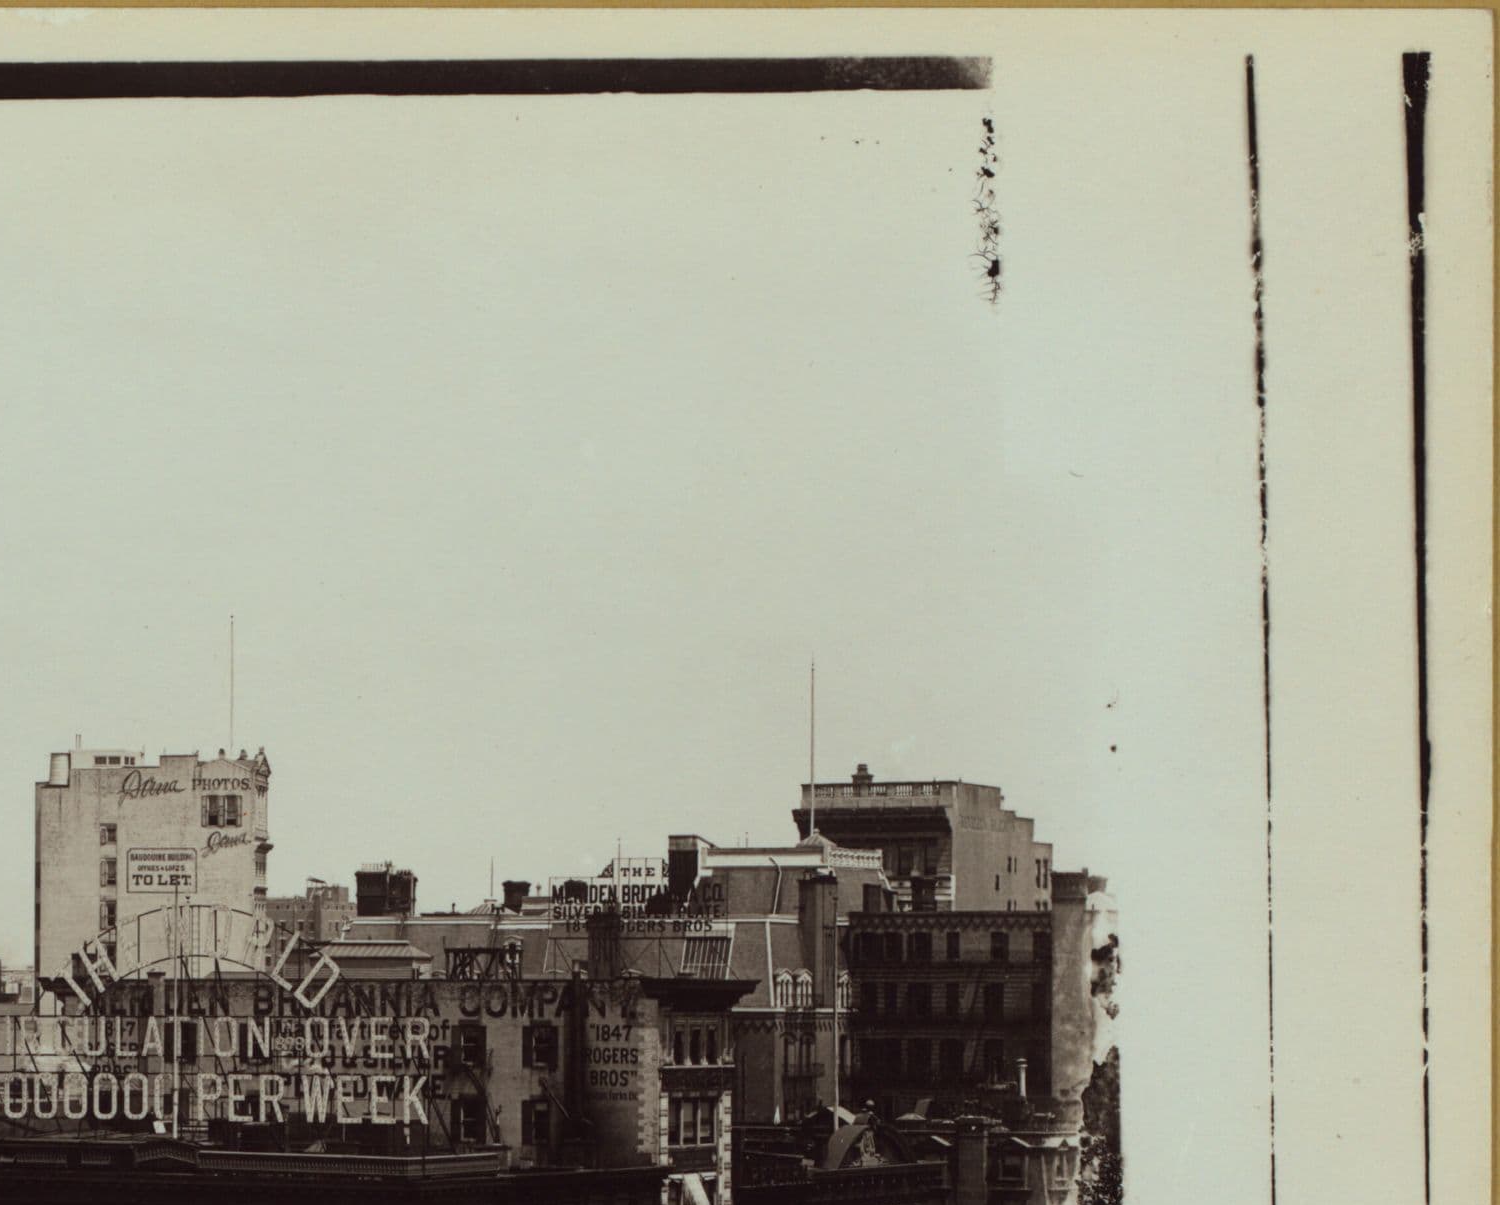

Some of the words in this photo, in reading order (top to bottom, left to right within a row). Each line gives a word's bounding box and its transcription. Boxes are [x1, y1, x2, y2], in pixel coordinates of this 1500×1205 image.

[192, 777, 251, 791] PHOTOS.
[132, 874, 153, 886] TO
[157, 874, 192, 886] LET.
[620, 867, 655, 877] THE
[552, 884, 617, 904] MDEN
[52, 915, 150, 1005] THE
[159, 903, 340, 1009] WORLD
[304, 1016, 431, 1059] OVER
[429, 1019, 450, 1041] of
[589, 1023, 633, 1042] "1847
[583, 1048, 638, 1065] ROGERS
[590, 1070, 638, 1087] BROS"
[197, 1073, 285, 1123] PER
[300, 1075, 429, 1125] WEEK
